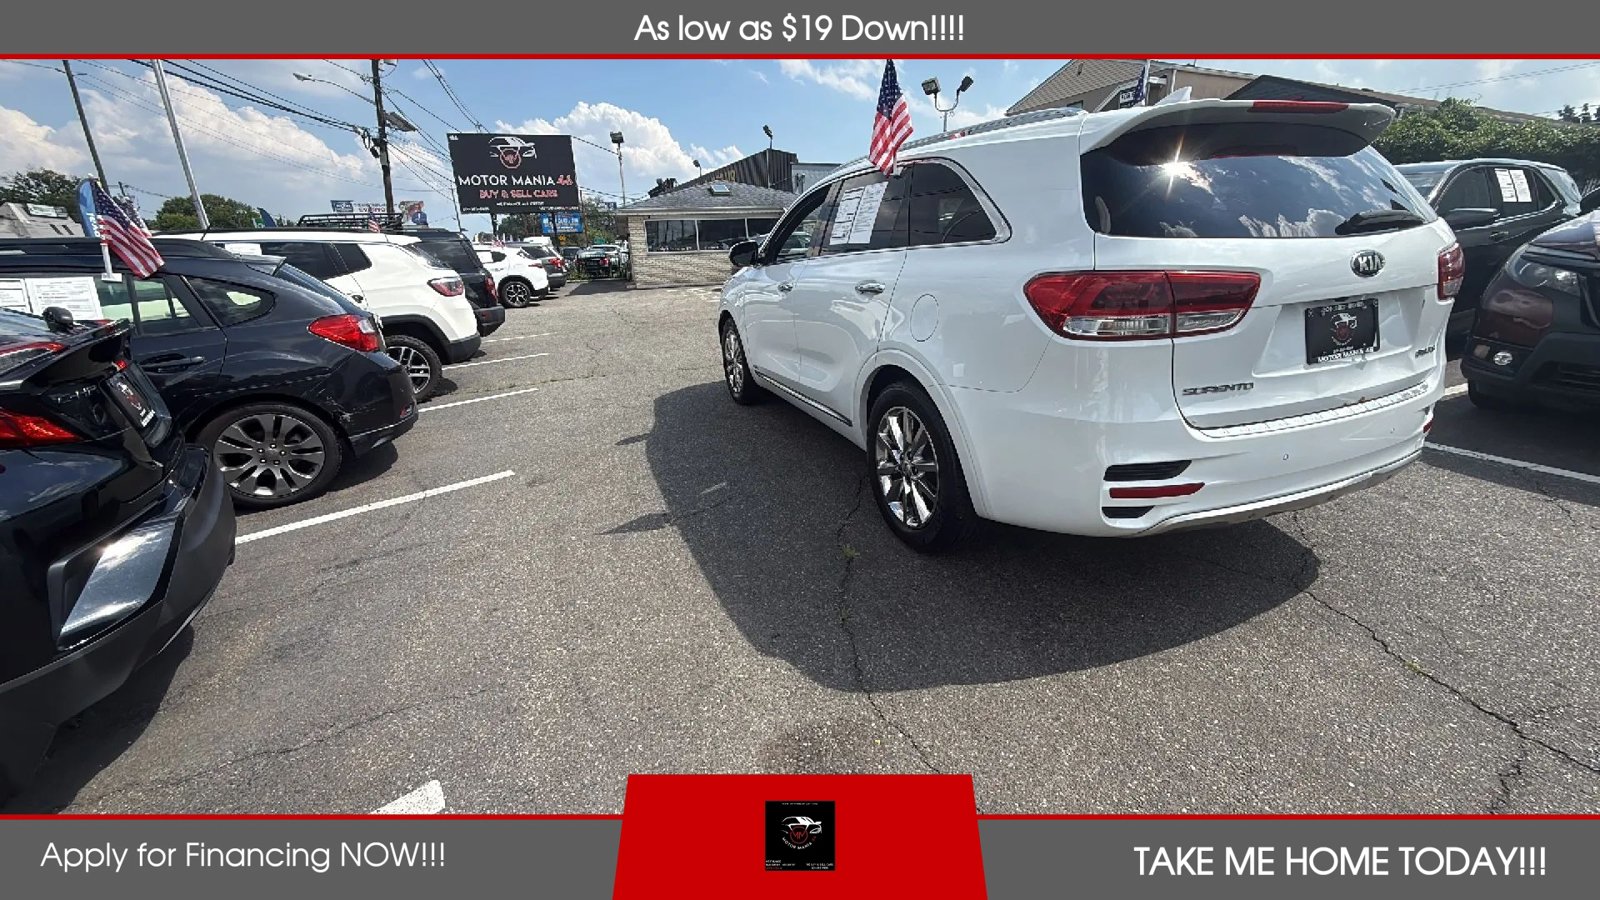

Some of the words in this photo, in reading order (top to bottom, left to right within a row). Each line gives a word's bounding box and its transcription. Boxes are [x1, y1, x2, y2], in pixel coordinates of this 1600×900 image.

[458, 174, 508, 186] MOTOR
[511, 174, 556, 186] MANIA
[479, 189, 499, 199] BUY
[511, 189, 533, 198] SELL
[533, 189, 558, 198] CARS
[1358, 255, 1382, 272] KIA
[1317, 353, 1342, 363] MOTOR
[1342, 348, 1364, 358] MANIA
[1182, 382, 1254, 396] SORENTO
